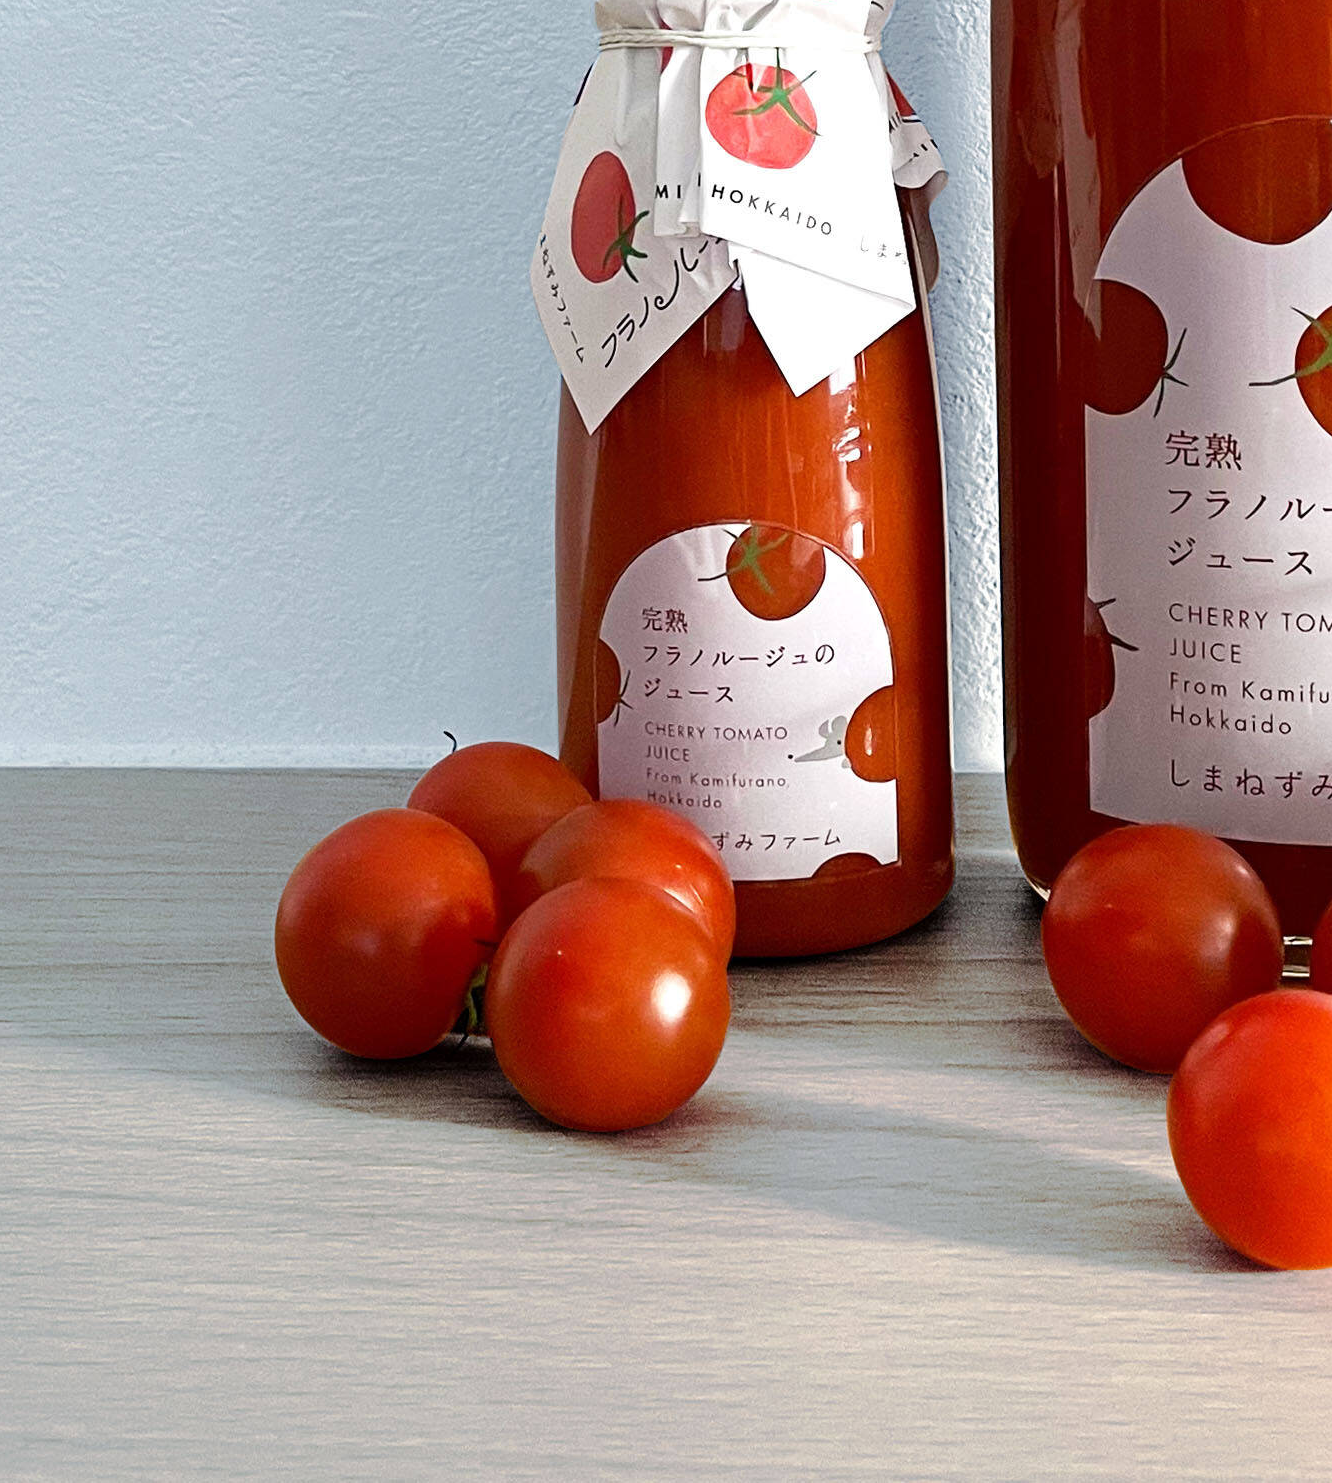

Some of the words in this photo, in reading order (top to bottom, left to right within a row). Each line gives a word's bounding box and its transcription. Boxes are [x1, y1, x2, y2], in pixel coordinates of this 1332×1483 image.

[710, 183, 833, 237] HOKKAIDO
[1164, 429, 1243, 471] 完熟
[1167, 535, 1313, 576] ジュース
[641, 606, 689, 635] 完熟
[1168, 602, 1269, 631] CHERRY
[643, 643, 836, 669] フラノルージュの
[1168, 637, 1243, 665] JUICE
[643, 677, 735, 704] ジュース
[1169, 671, 1228, 699] From
[643, 720, 706, 740] CHERRY
[713, 725, 789, 742] TOMATO
[1169, 704, 1293, 736] Hokkaido
[645, 744, 691, 763] JUICE
[646, 766, 683, 785] From
[689, 771, 790, 790] Kamifurano,
[646, 789, 723, 810] Hokkaido
[711, 828, 842, 852] ずみファーム
